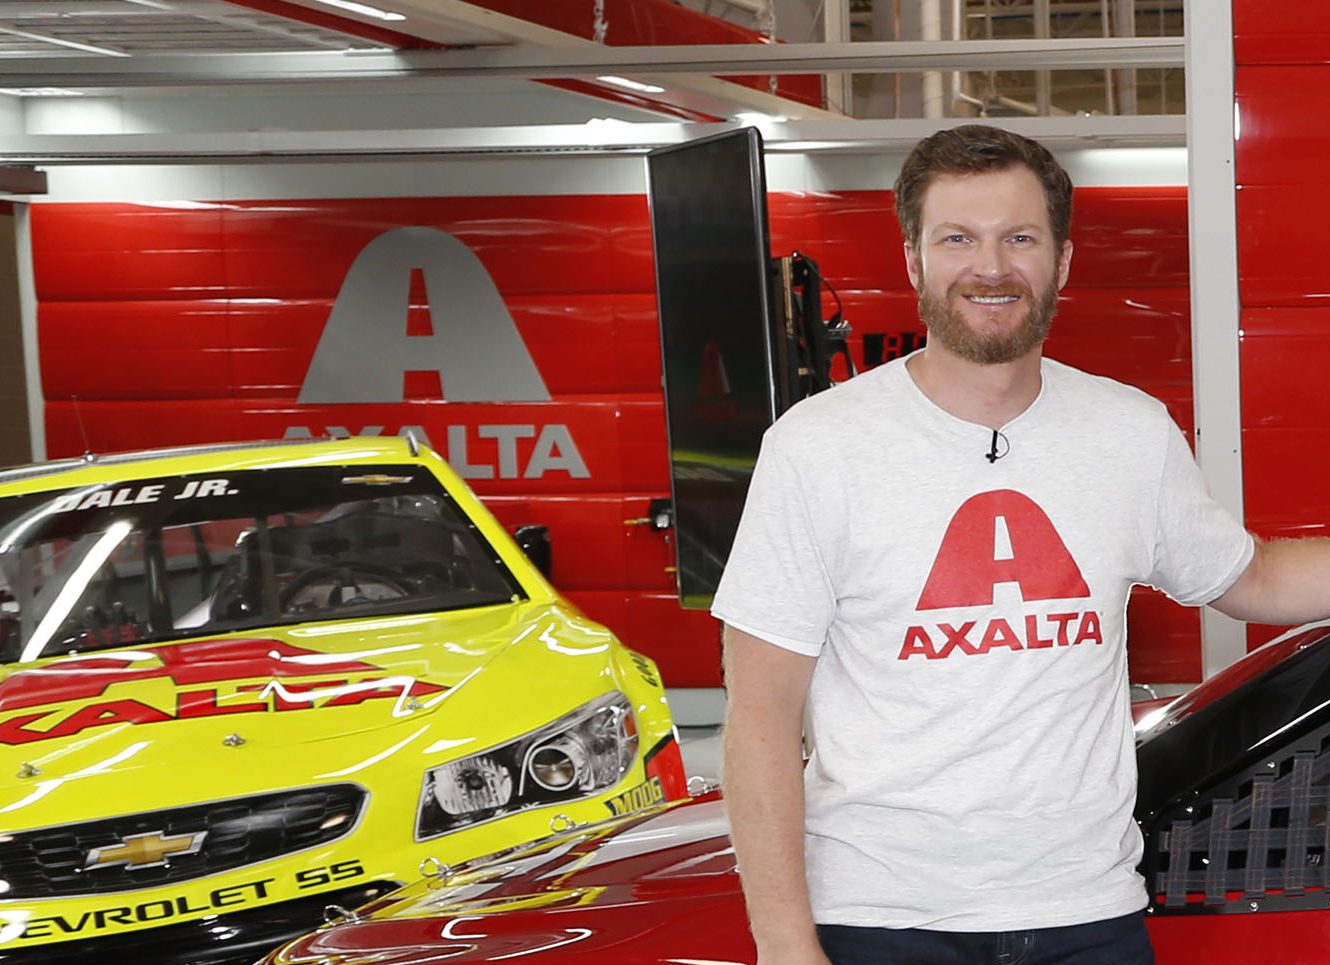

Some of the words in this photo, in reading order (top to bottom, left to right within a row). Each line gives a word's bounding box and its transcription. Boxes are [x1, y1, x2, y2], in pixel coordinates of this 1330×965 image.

[283, 424, 591, 479] LTA
[50, 484, 165, 513] DALE
[174, 479, 239, 499] JR.
[897, 611, 1103, 660] AXALTA
[614, 776, 664, 816] MOOG
[16, 878, 276, 939] EVROLET
[296, 860, 365, 891] SS
